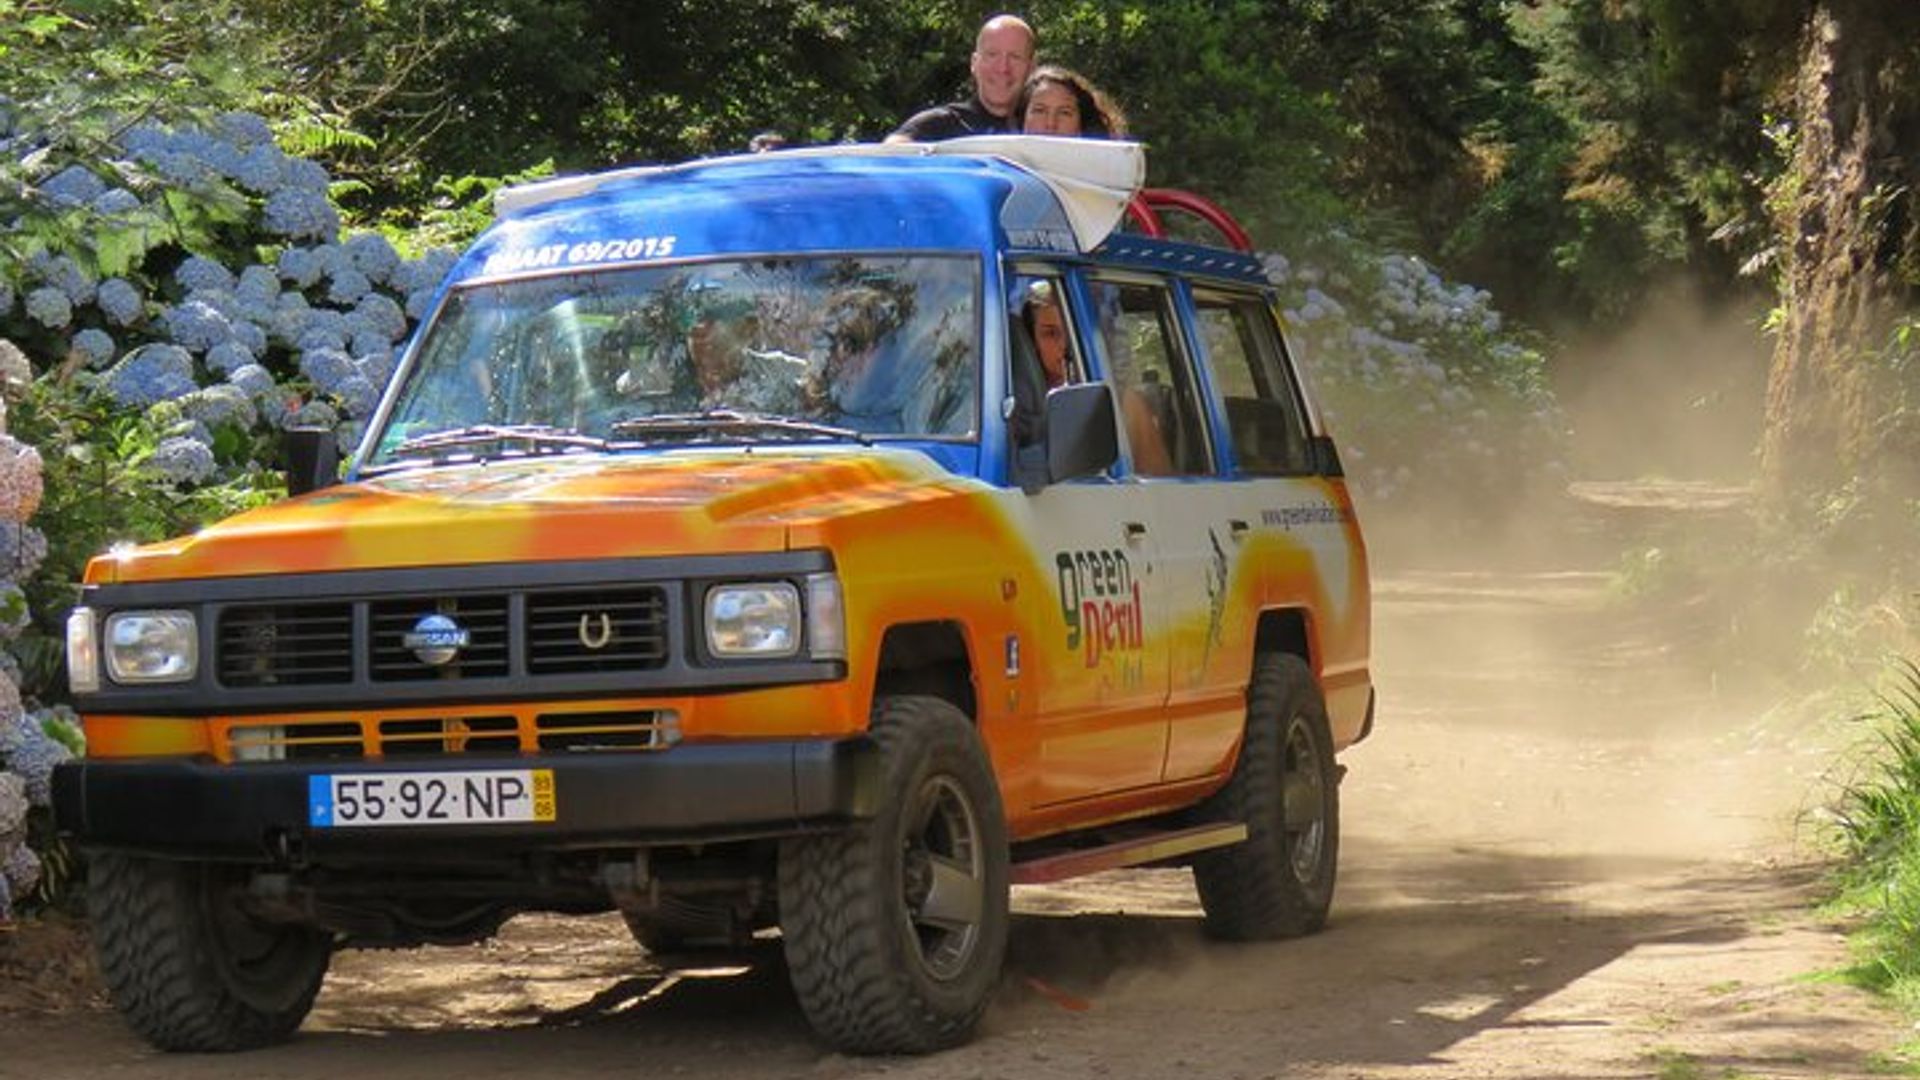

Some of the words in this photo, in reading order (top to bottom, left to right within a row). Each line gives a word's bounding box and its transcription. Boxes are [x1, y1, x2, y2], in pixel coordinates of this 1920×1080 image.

[568, 236, 676, 263] 69/2015
[1056, 549, 1132, 650] green
[404, 628, 469, 647] SSAN
